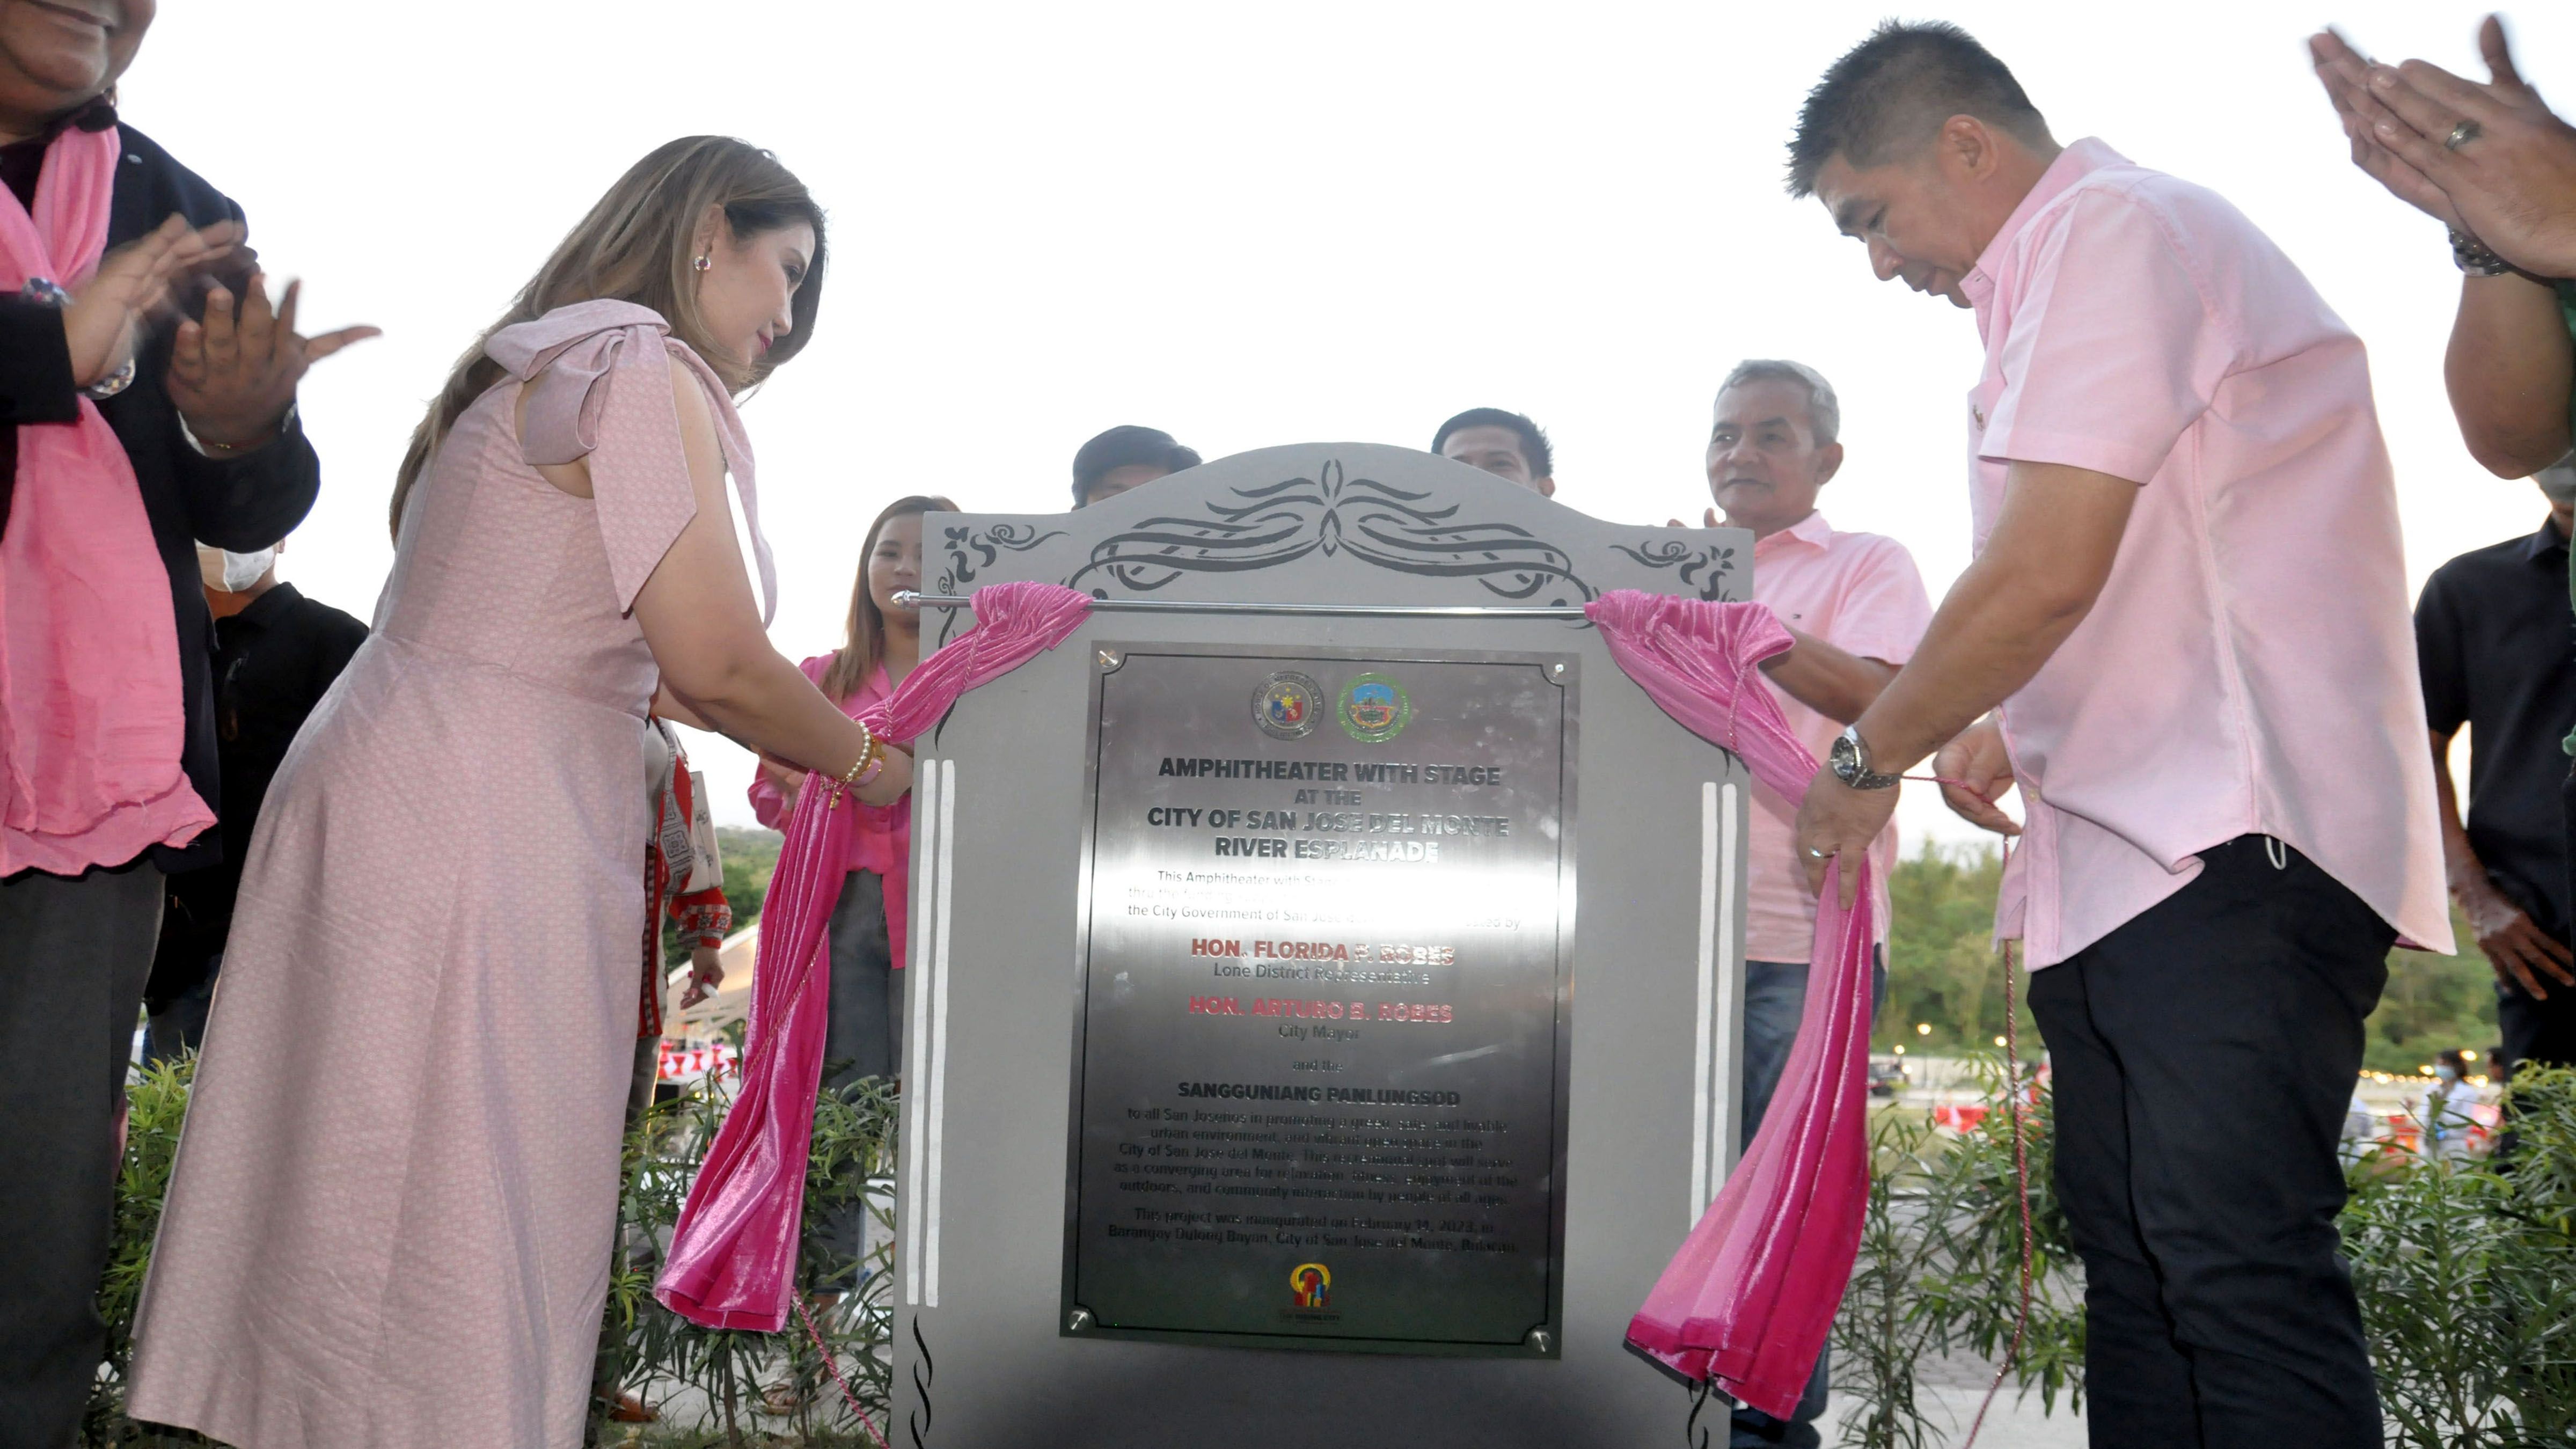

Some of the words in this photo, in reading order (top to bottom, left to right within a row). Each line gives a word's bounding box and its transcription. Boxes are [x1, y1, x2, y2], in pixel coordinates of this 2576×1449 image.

[1159, 757, 1348, 781] AMPHITHEATER
[1353, 762, 1418, 784] WITH
[1424, 764, 1501, 786] STAGE
[1294, 789, 1319, 804] AT
[1324, 789, 1362, 806] THE
[1147, 807, 1203, 827] CITY
[1208, 809, 1241, 829] OF
[1246, 810, 1297, 830] SAN
[1302, 811, 1363, 832] JOSE
[1369, 813, 1415, 834] DEL
[1421, 814, 1509, 837] MONTE
[1215, 836, 1288, 859] RIVER
[1294, 839, 1439, 863] ESPLANADE
[1158, 870, 1182, 883] This
[1186, 871, 1270, 885] Amphitheater
[1274, 875, 1300, 885] with
[1128, 904, 1149, 916] the
[1153, 904, 1177, 920] City
[1182, 905, 1262, 920] Government
[1267, 909, 1279, 920] of
[1284, 909, 1308, 922] San
[1505, 918, 1521, 931] by
[1191, 938, 1248, 958] HON.
[1254, 940, 1350, 963] FLORIDA
[1353, 943, 1374, 963] P.
[1379, 943, 1455, 966] ROBES
[1214, 962, 1251, 978] Lone
[1256, 964, 1311, 980] District
[1314, 967, 1430, 985] Representative
[1188, 996, 1245, 1016] HON.
[1251, 997, 1344, 1020] ARTURO
[1349, 1001, 1372, 1021] B.
[1378, 1001, 1453, 1023] ROBES
[1278, 1023, 1308, 1042] City
[1312, 1024, 1361, 1042] Mayor
[1292, 1060, 1318, 1072] and
[1322, 1060, 1344, 1073] the
[1178, 1082, 1322, 1103] SANGGUNIANG
[1327, 1087, 1461, 1108] PANLUNGSOD
[1128, 1108, 1140, 1119] to
[1144, 1108, 1160, 1120] all
[1163, 1108, 1188, 1121] San
[1250, 1111, 1262, 1123] in
[1266, 1114, 1335, 1130] promoting
[1150, 1128, 1189, 1139] urban
[1119, 1143, 1144, 1159] City
[1148, 1144, 1162, 1157] of
[1165, 1144, 1189, 1158] San
[1192, 1146, 1224, 1160] Jose
[1227, 1147, 1248, 1160] del
[1114, 1163, 1128, 1173] as
[1144, 1164, 1218, 1180] converging
[1222, 1167, 1251, 1179] area
[1255, 1166, 1273, 1179] for
[1187, 1182, 1211, 1195] and
[1215, 1184, 1289, 1200] community
[1368, 1188, 1384, 1204] by
[1134, 1207, 1160, 1221] This
[1166, 1210, 1211, 1225] project
[1216, 1213, 1242, 1224] was
[1331, 1218, 1348, 1229] on
[1351, 1216, 1411, 1234] February
[1108, 1224, 1172, 1242] Barangay
[1175, 1227, 1223, 1245] Dulong
[1276, 1233, 1302, 1248] City
